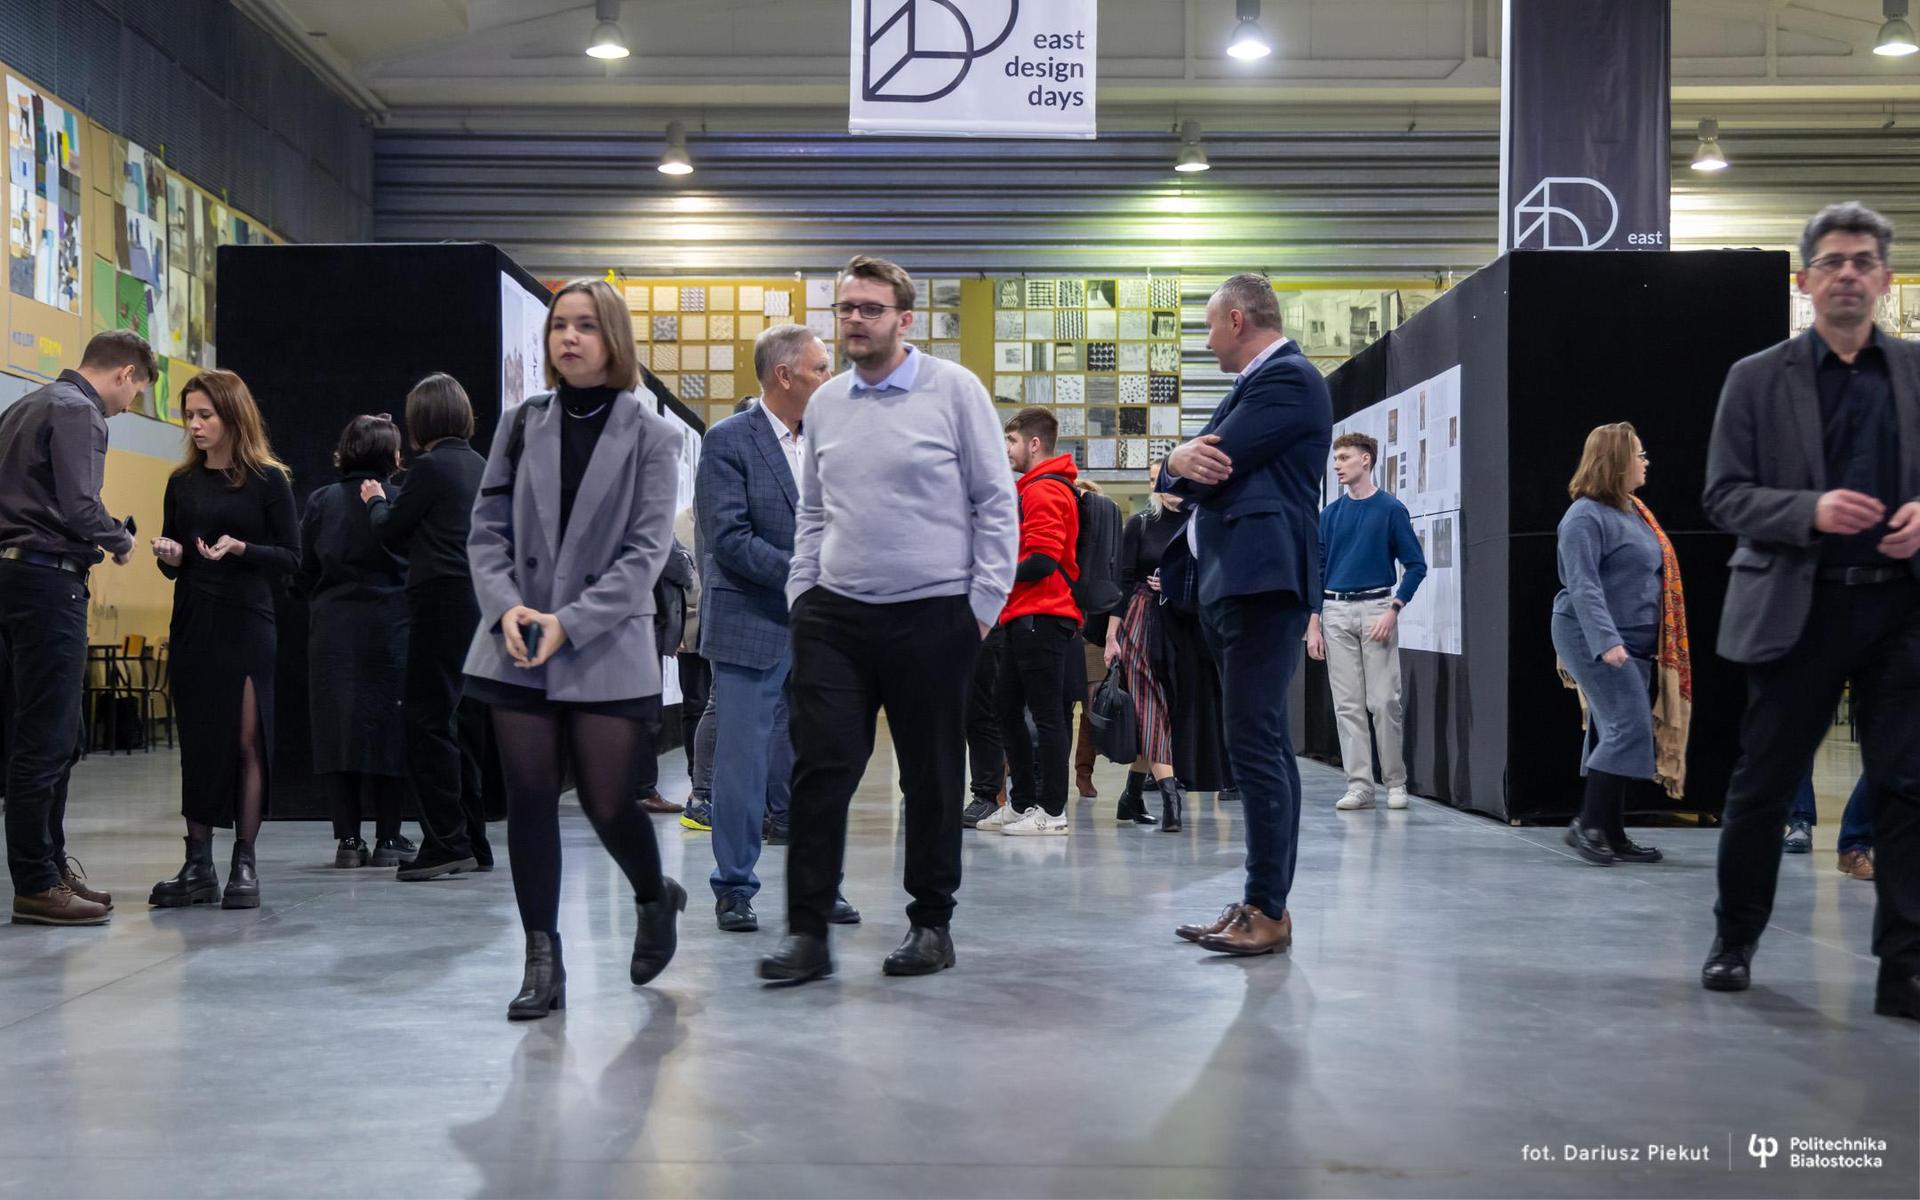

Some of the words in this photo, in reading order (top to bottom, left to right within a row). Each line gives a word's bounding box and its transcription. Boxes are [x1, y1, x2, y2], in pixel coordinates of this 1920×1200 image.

[1033, 30, 1085, 50] east
[1004, 56, 1085, 82] design
[1027, 84, 1085, 111] days
[1627, 230, 1663, 245] east
